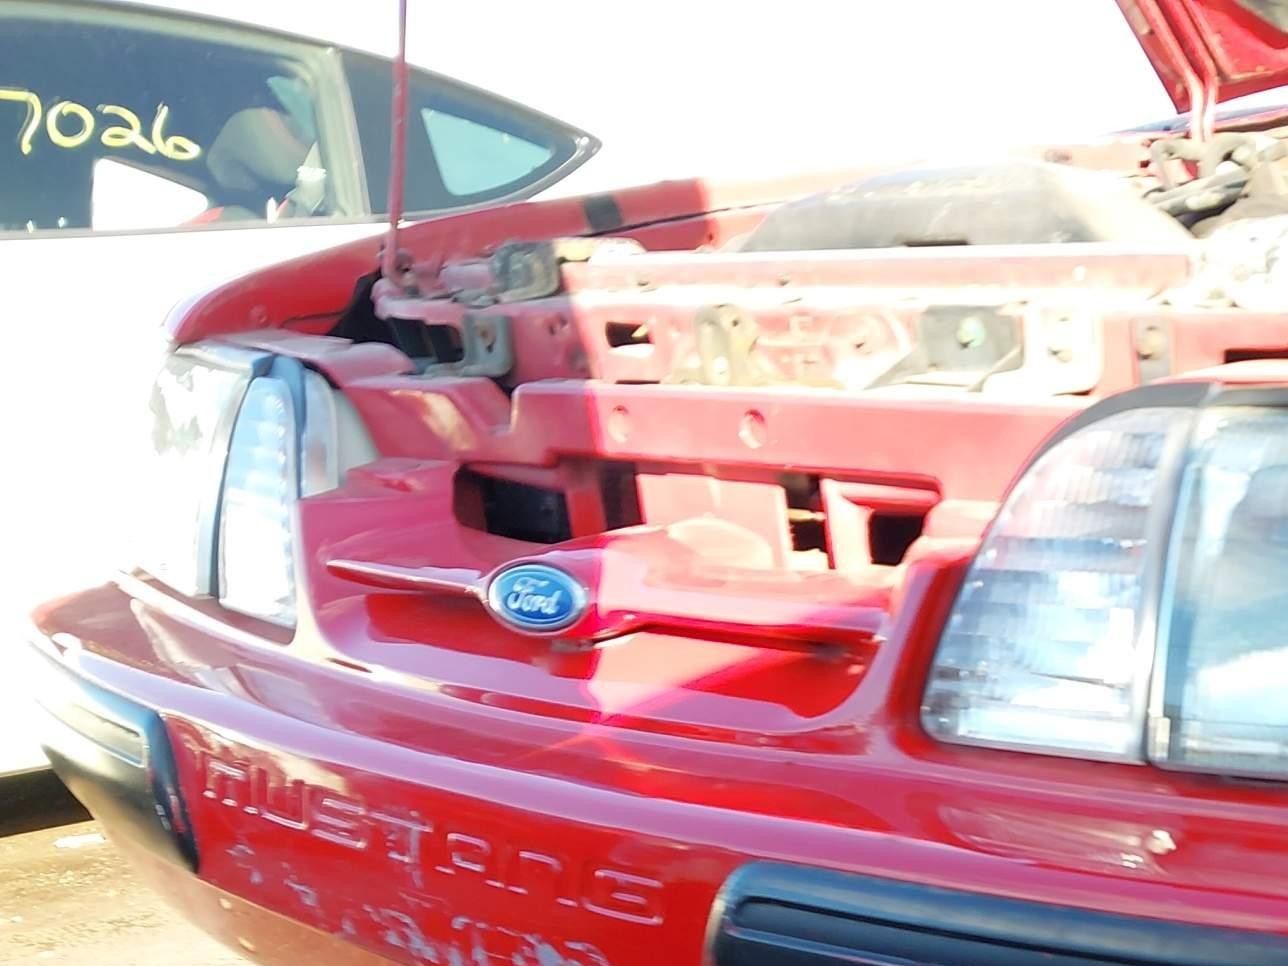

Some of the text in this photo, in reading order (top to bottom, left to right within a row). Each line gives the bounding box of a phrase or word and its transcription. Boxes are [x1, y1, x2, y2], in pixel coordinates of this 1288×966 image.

[0, 86, 201, 161] 7026
[506, 576, 563, 615] Ford
[201, 759, 664, 926] MUSTANG
